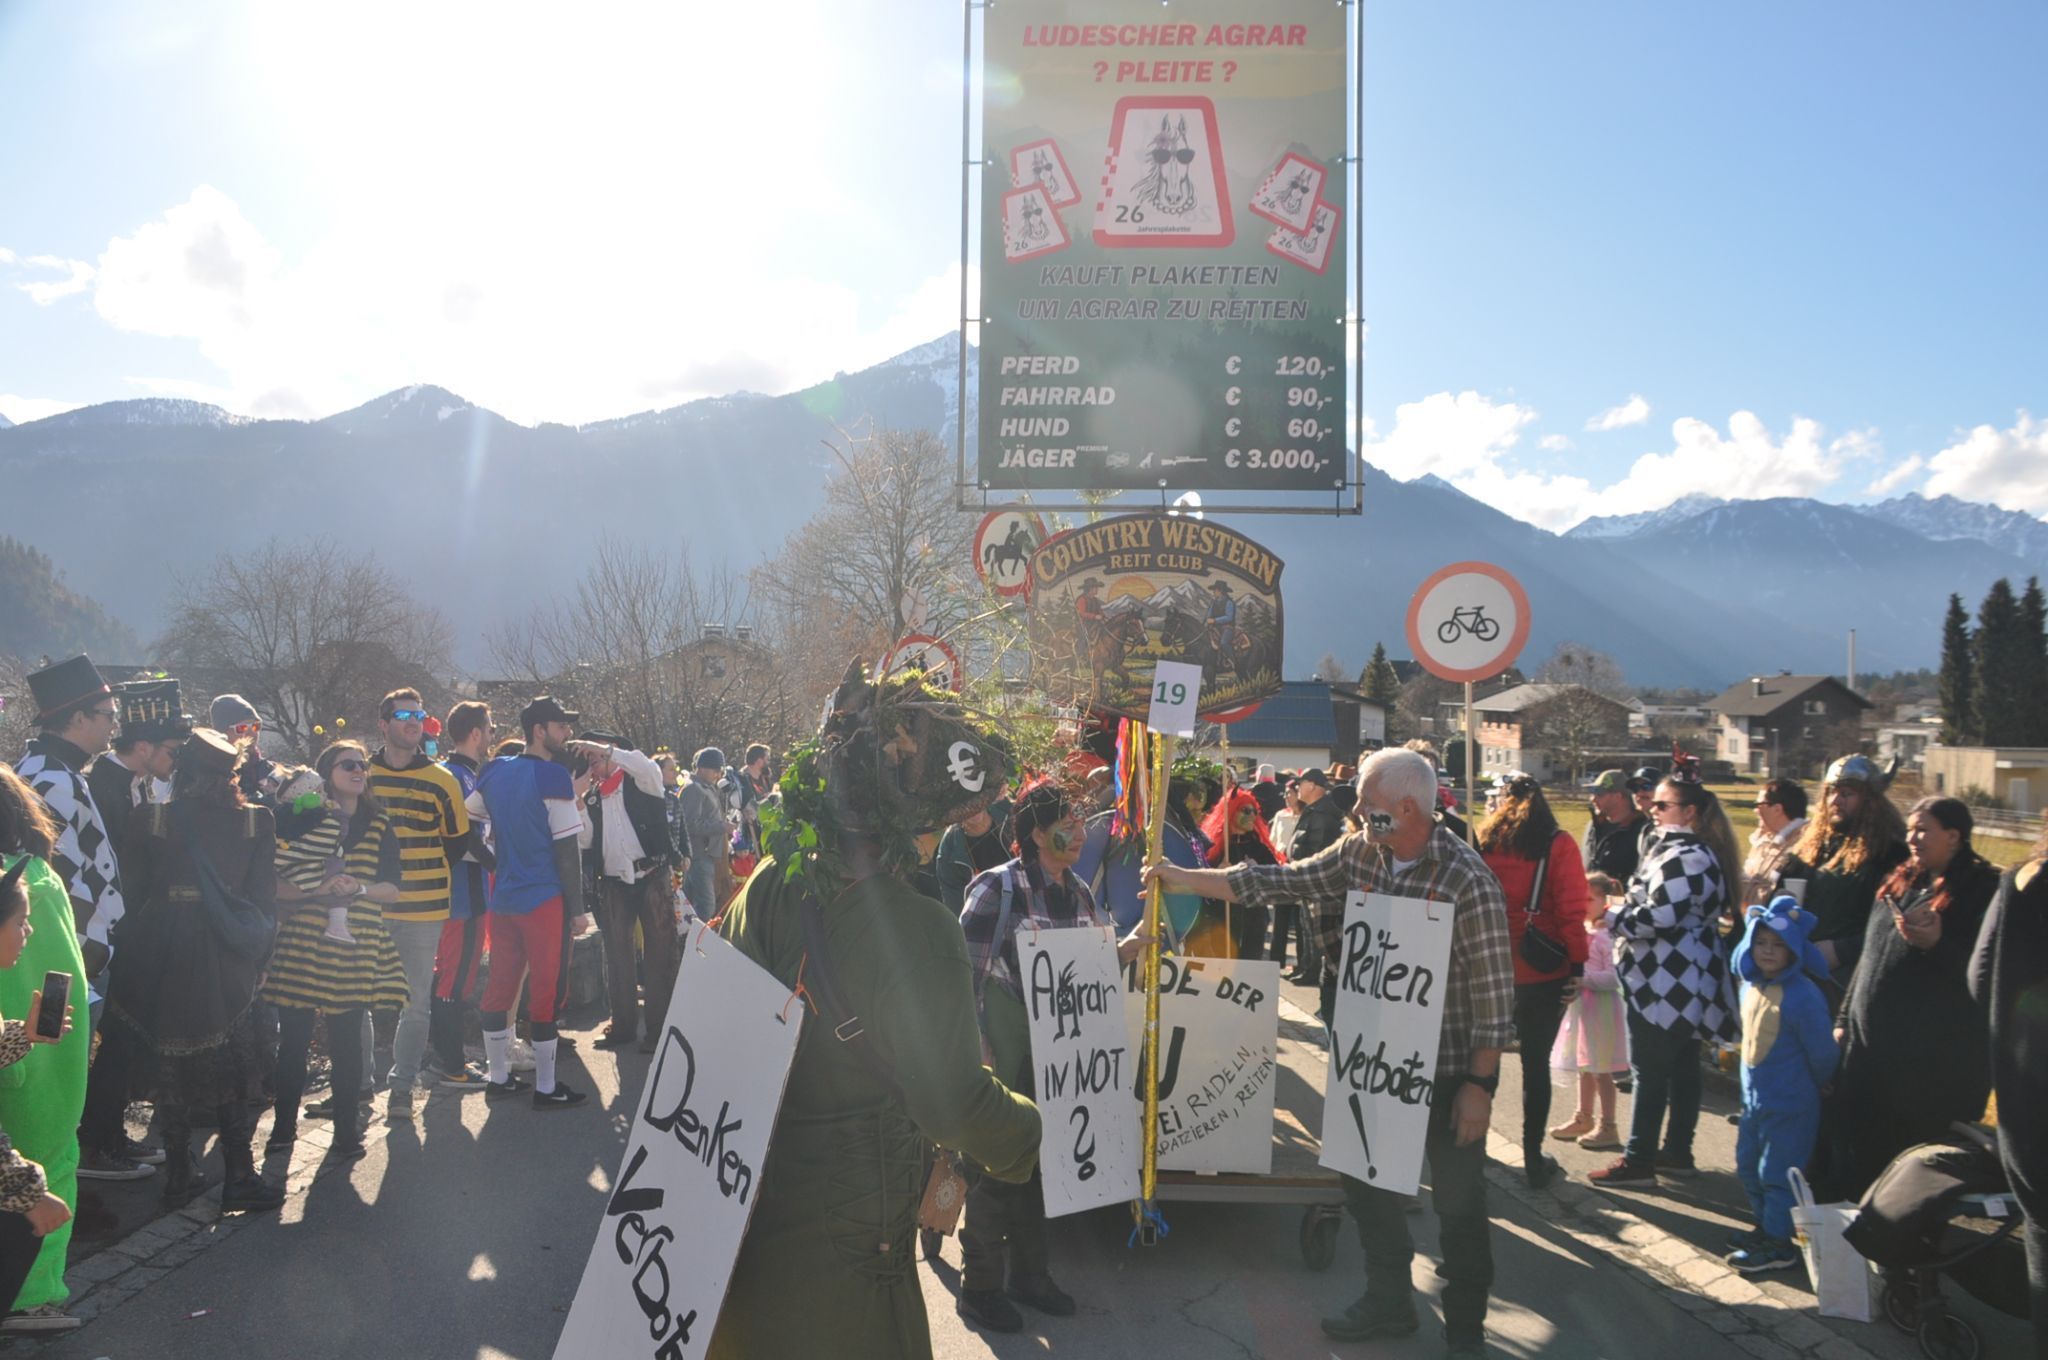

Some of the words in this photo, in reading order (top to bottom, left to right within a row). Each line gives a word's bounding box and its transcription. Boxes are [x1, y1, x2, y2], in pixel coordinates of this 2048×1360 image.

[1022, 24, 1197, 47] LUDESCHER
[1204, 24, 1307, 47] AGRAR
[1093, 61, 1109, 83] ?
[1116, 61, 1213, 83] PLEITE
[1223, 61, 1238, 83] ?
[1115, 205, 1144, 223] 26
[1261, 197, 1276, 209] 26
[1014, 240, 1028, 251] 26
[1278, 237, 1292, 249] 26
[1039, 265, 1124, 286] KAUFT
[1130, 265, 1280, 286] PLAKETTEN
[1017, 298, 1059, 321] UM
[1065, 298, 1157, 321] AGRAR
[1165, 298, 1201, 321] ZU
[1208, 298, 1308, 321] RETTEN
[1000, 356, 1079, 375] PFERD
[1225, 356, 1241, 375] €
[1275, 356, 1335, 379] 120,-
[1000, 387, 1115, 405] FAHRRAD
[1225, 387, 1241, 405] €
[1287, 387, 1332, 410] 90,-
[1000, 418, 1070, 437] HUND
[1225, 418, 1241, 437] €
[1287, 418, 1332, 441] 60,-
[998, 444, 1077, 468] JÄGER
[1225, 449, 1240, 468] €
[1246, 449, 1329, 473] 3.000,-
[1035, 519, 1154, 583] COUNTRY
[1160, 519, 1279, 585] WESTERN
[1110, 553, 1153, 571] REIT
[1157, 553, 1202, 570] CLUB
[1154, 680, 1187, 706] 19
[1343, 921, 1433, 1007] Reiten
[1215, 976, 1264, 1012] DER
[1044, 1063, 1067, 1101] IN
[1075, 1047, 1125, 1095] NOT
[1331, 1031, 1432, 1107] Verboten
[1140, 1105, 1183, 1136] EI
[1070, 1105, 1096, 1181] ?
[1349, 1093, 1377, 1180] !
[607, 1144, 697, 1360] Verbot
